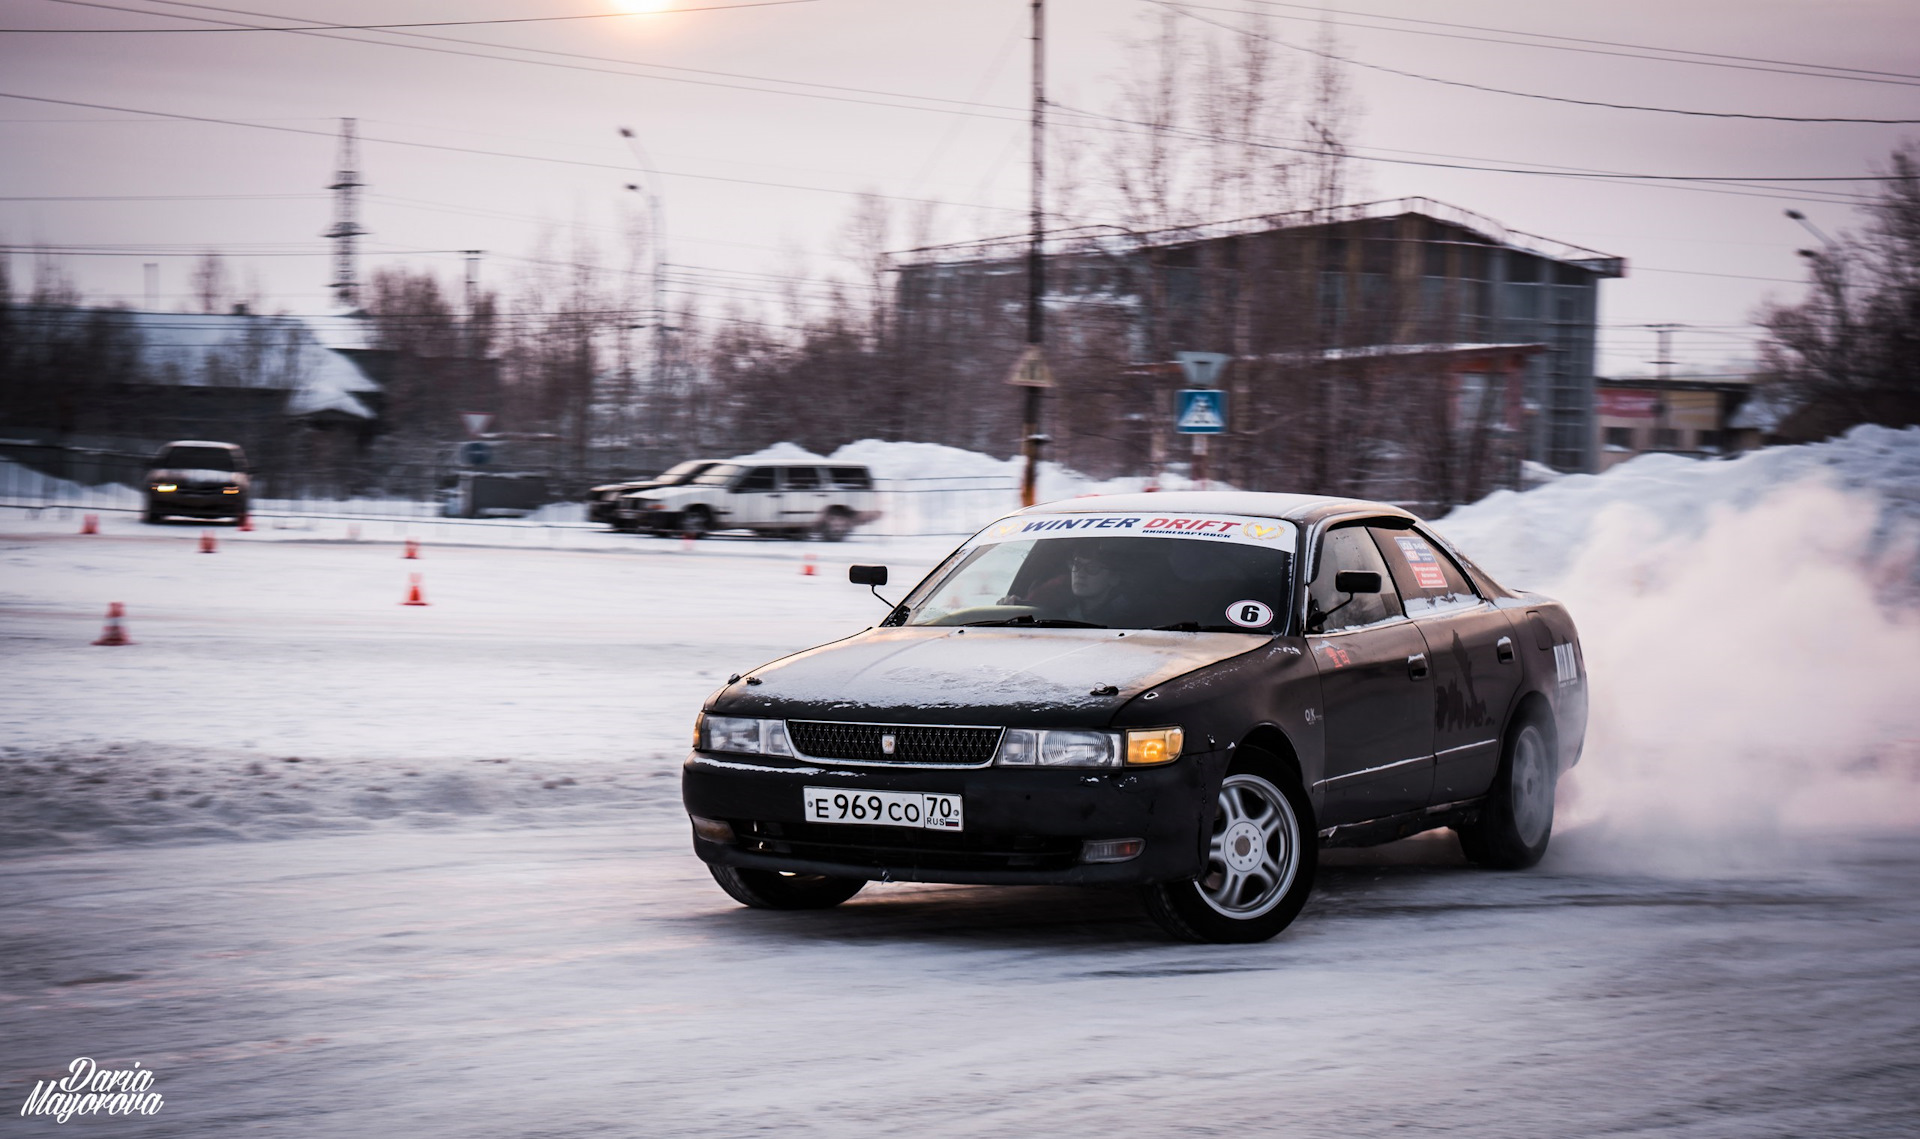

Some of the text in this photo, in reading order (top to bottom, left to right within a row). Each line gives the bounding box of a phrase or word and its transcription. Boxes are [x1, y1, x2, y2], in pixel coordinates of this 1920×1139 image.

[1021, 517, 1242, 533] WINTER DRIFT
[1240, 604, 1260, 623] 6
[926, 797, 952, 818] 70
[926, 817, 945, 826] RUS
